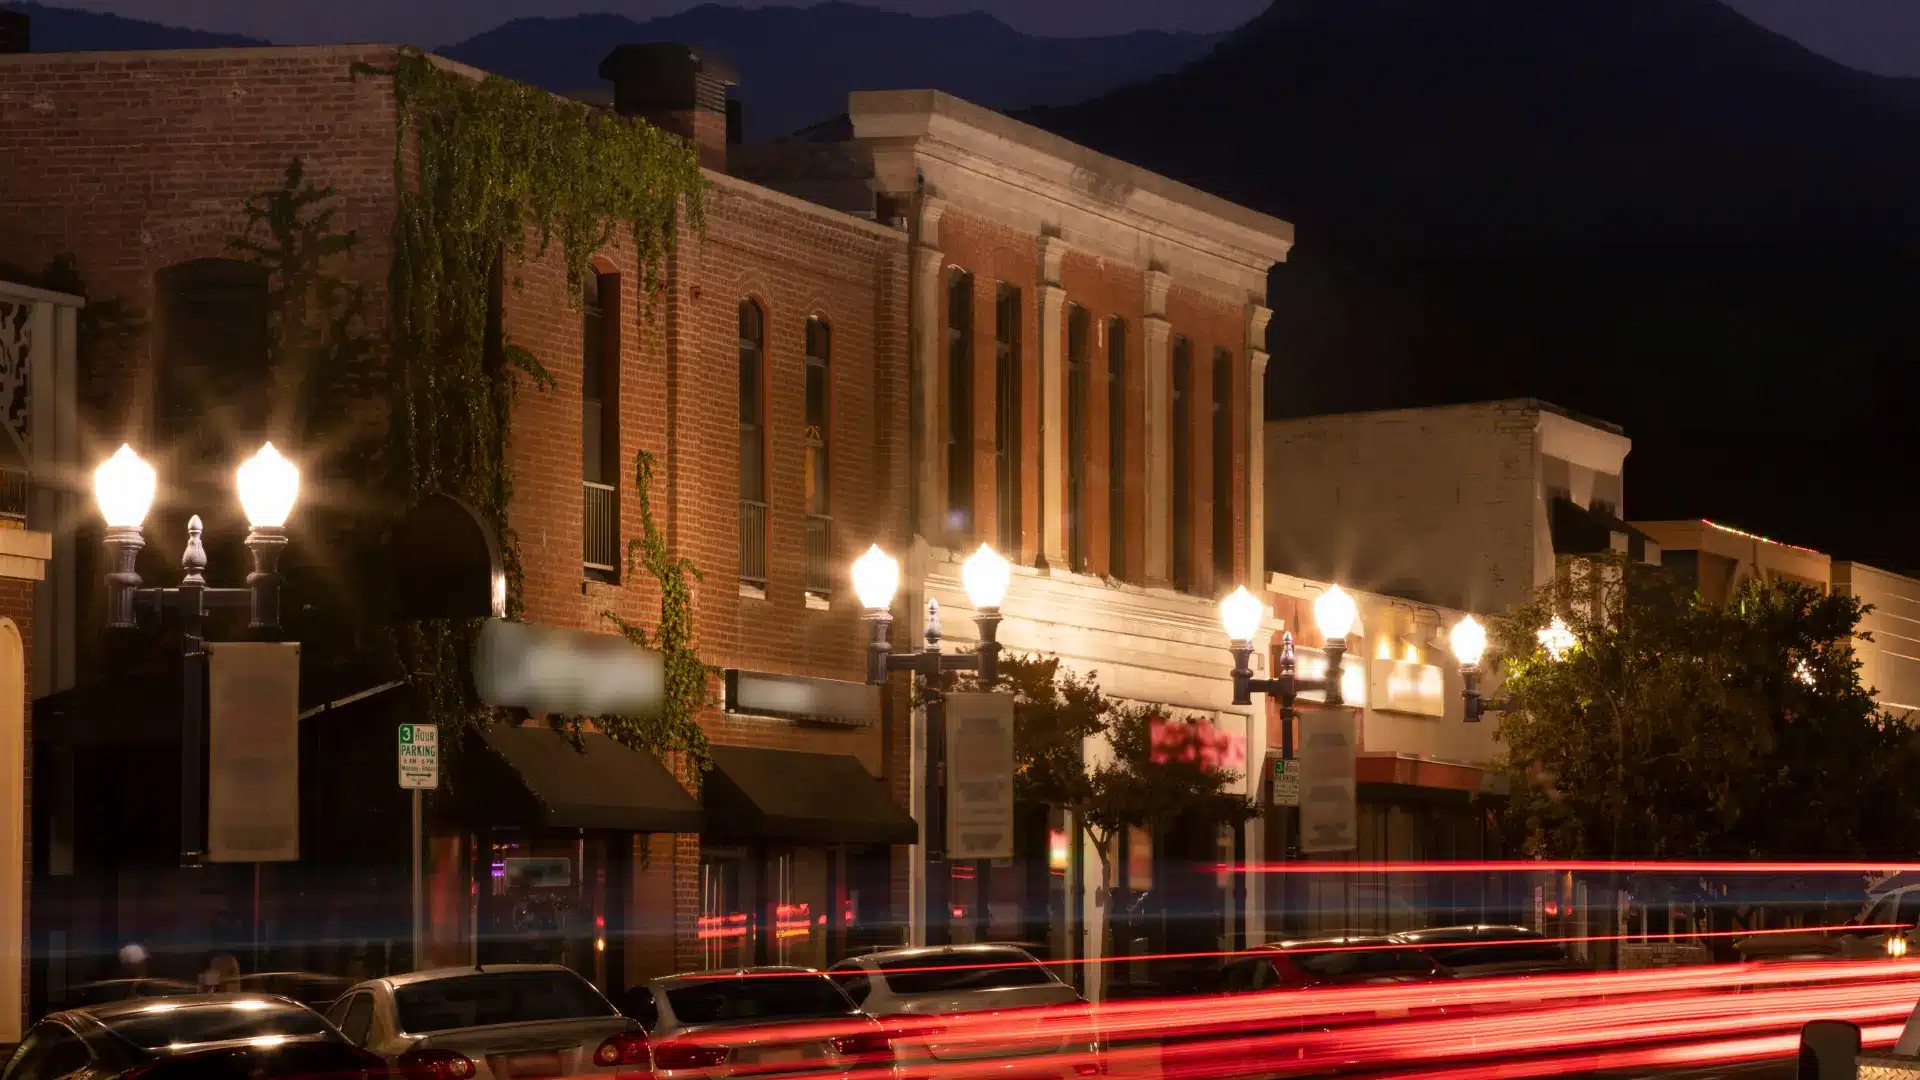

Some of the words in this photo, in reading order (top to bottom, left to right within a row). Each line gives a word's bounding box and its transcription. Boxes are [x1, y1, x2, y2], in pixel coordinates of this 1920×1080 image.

[402, 727, 411, 741] 3
[415, 731, 435, 741] HOUR
[401, 745, 436, 757] PARKING
[1275, 775, 1299, 784] PARKIN
